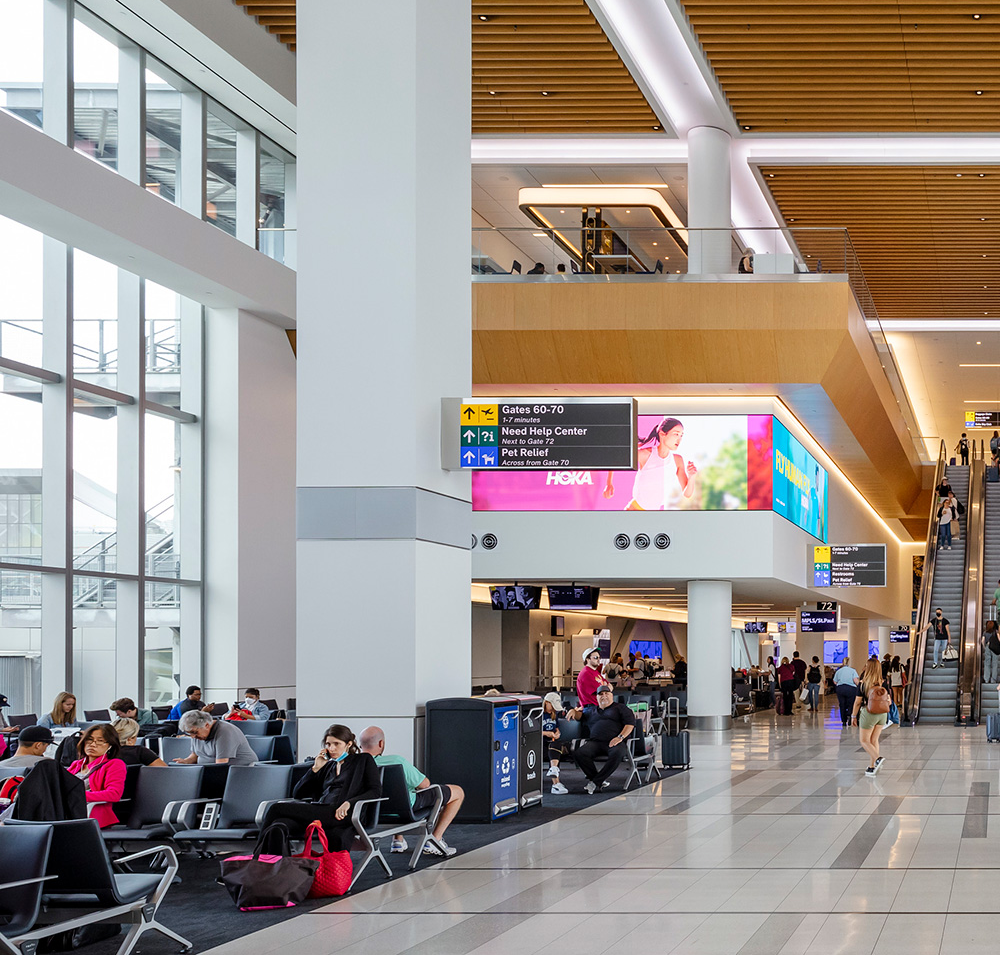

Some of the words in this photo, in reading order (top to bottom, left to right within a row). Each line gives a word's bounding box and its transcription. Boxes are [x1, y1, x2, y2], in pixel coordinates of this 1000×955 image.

[502, 405, 530, 414] Gates
[533, 405, 564, 414] 60-70
[502, 427, 528, 435] Need
[530, 427, 552, 437] Help
[554, 427, 587, 435] Center
[502, 448, 518, 456] Pet
[520, 448, 549, 456] Relief
[546, 471, 594, 485] HOKA
[821, 602, 833, 610] 72
